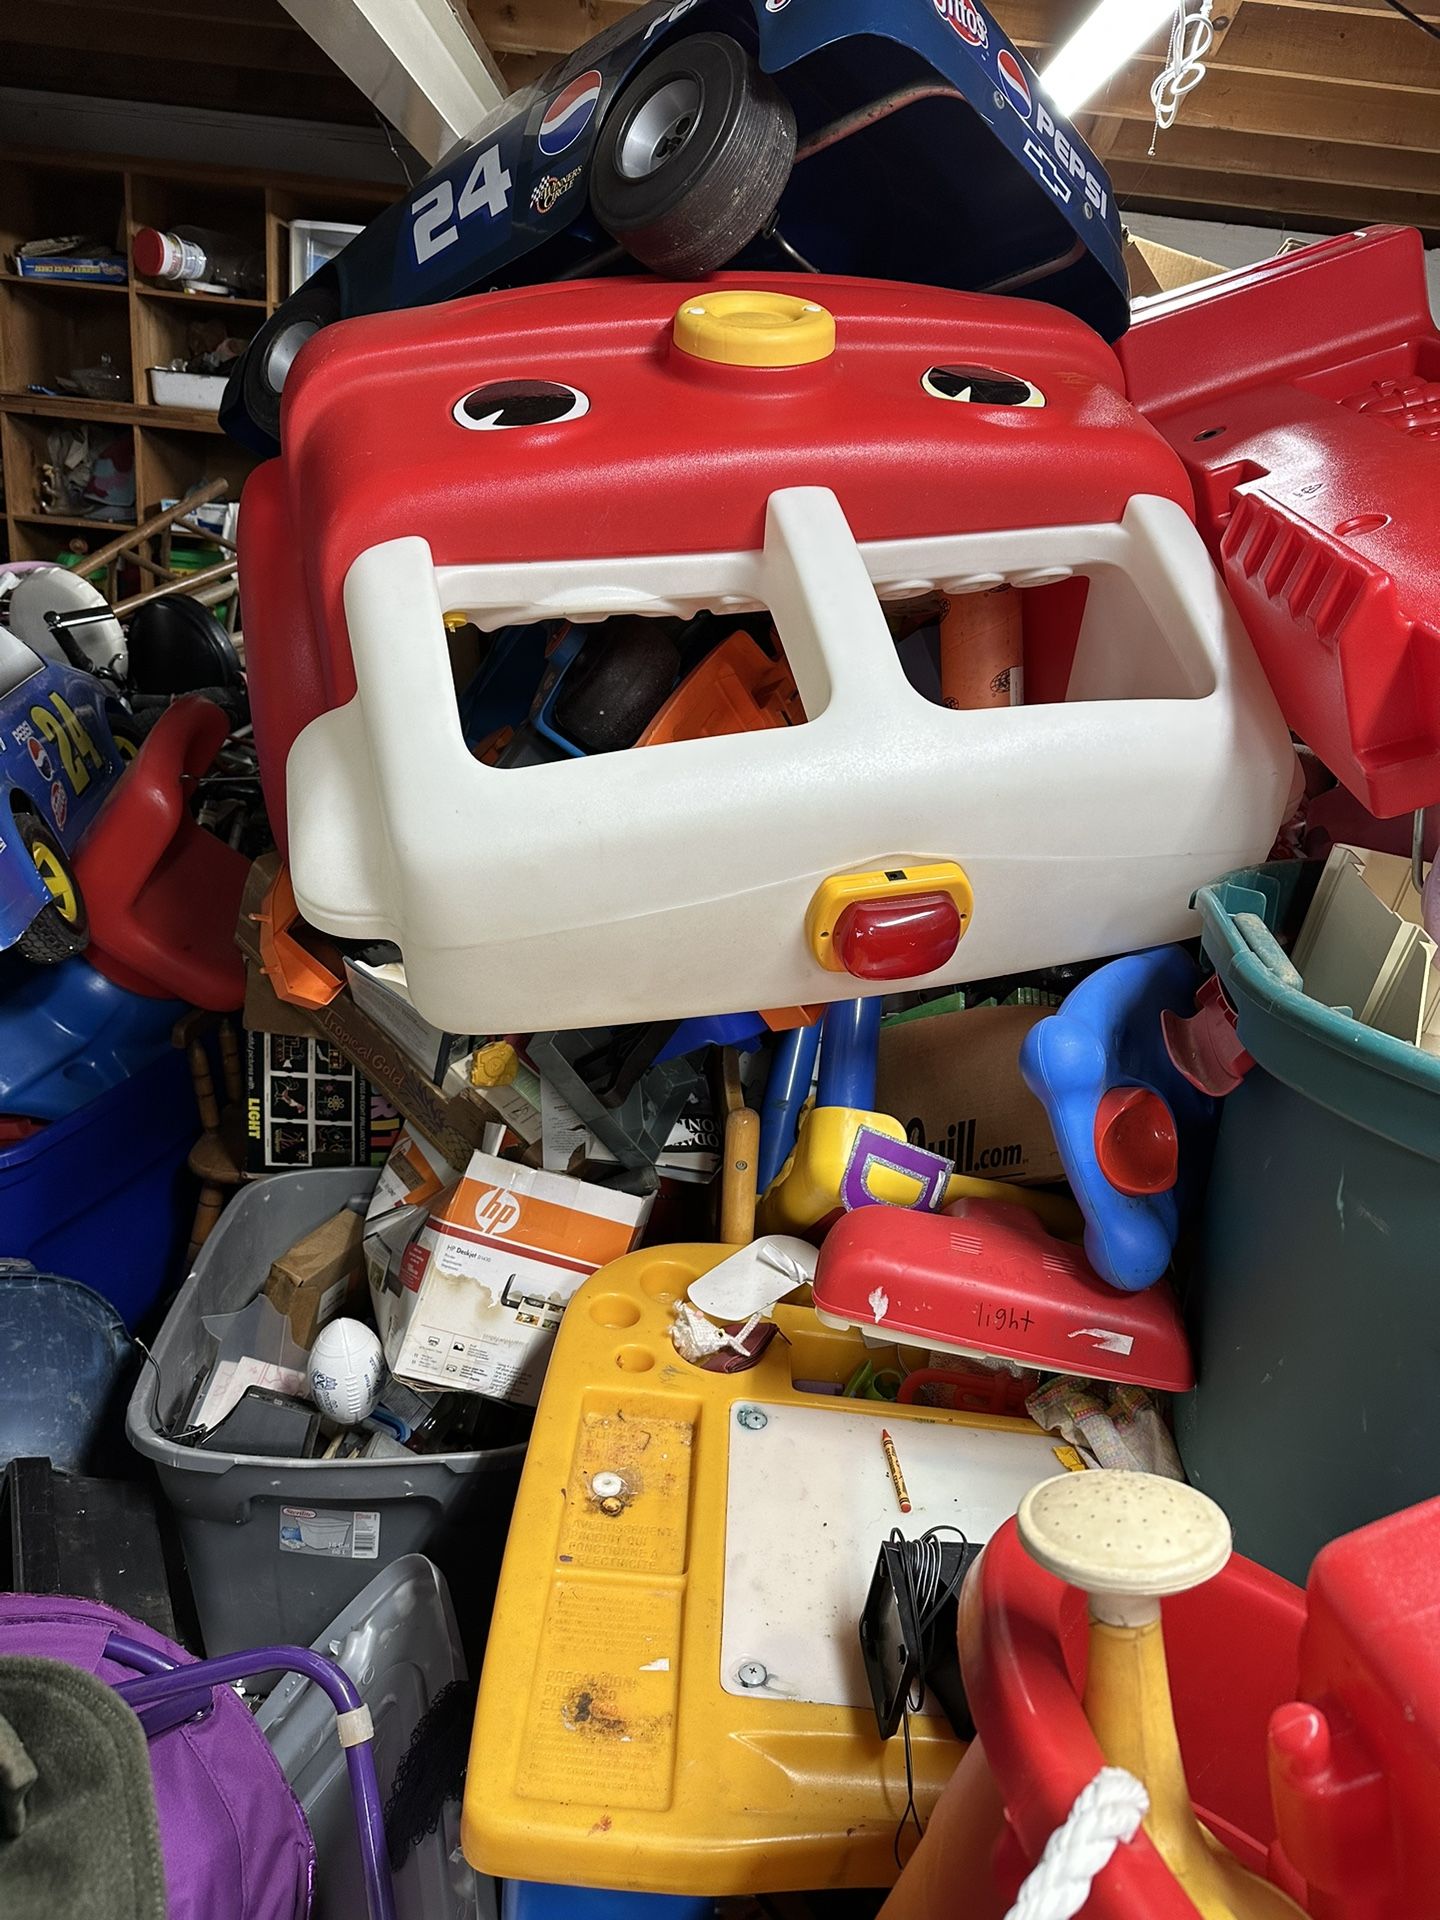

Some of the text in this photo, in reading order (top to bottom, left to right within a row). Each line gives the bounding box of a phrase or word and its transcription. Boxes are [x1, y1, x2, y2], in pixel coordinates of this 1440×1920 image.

[1036, 103, 1108, 219] PEPSI
[411, 143, 513, 265] 24
[31, 691, 103, 796] 24
[322, 1007, 406, 1088] Tropical Gold
[248, 1098, 261, 1139] LIGHT
[479, 1187, 517, 1235] hp
[456, 1247, 477, 1259] Deskjet
[976, 1302, 1035, 1332] light
